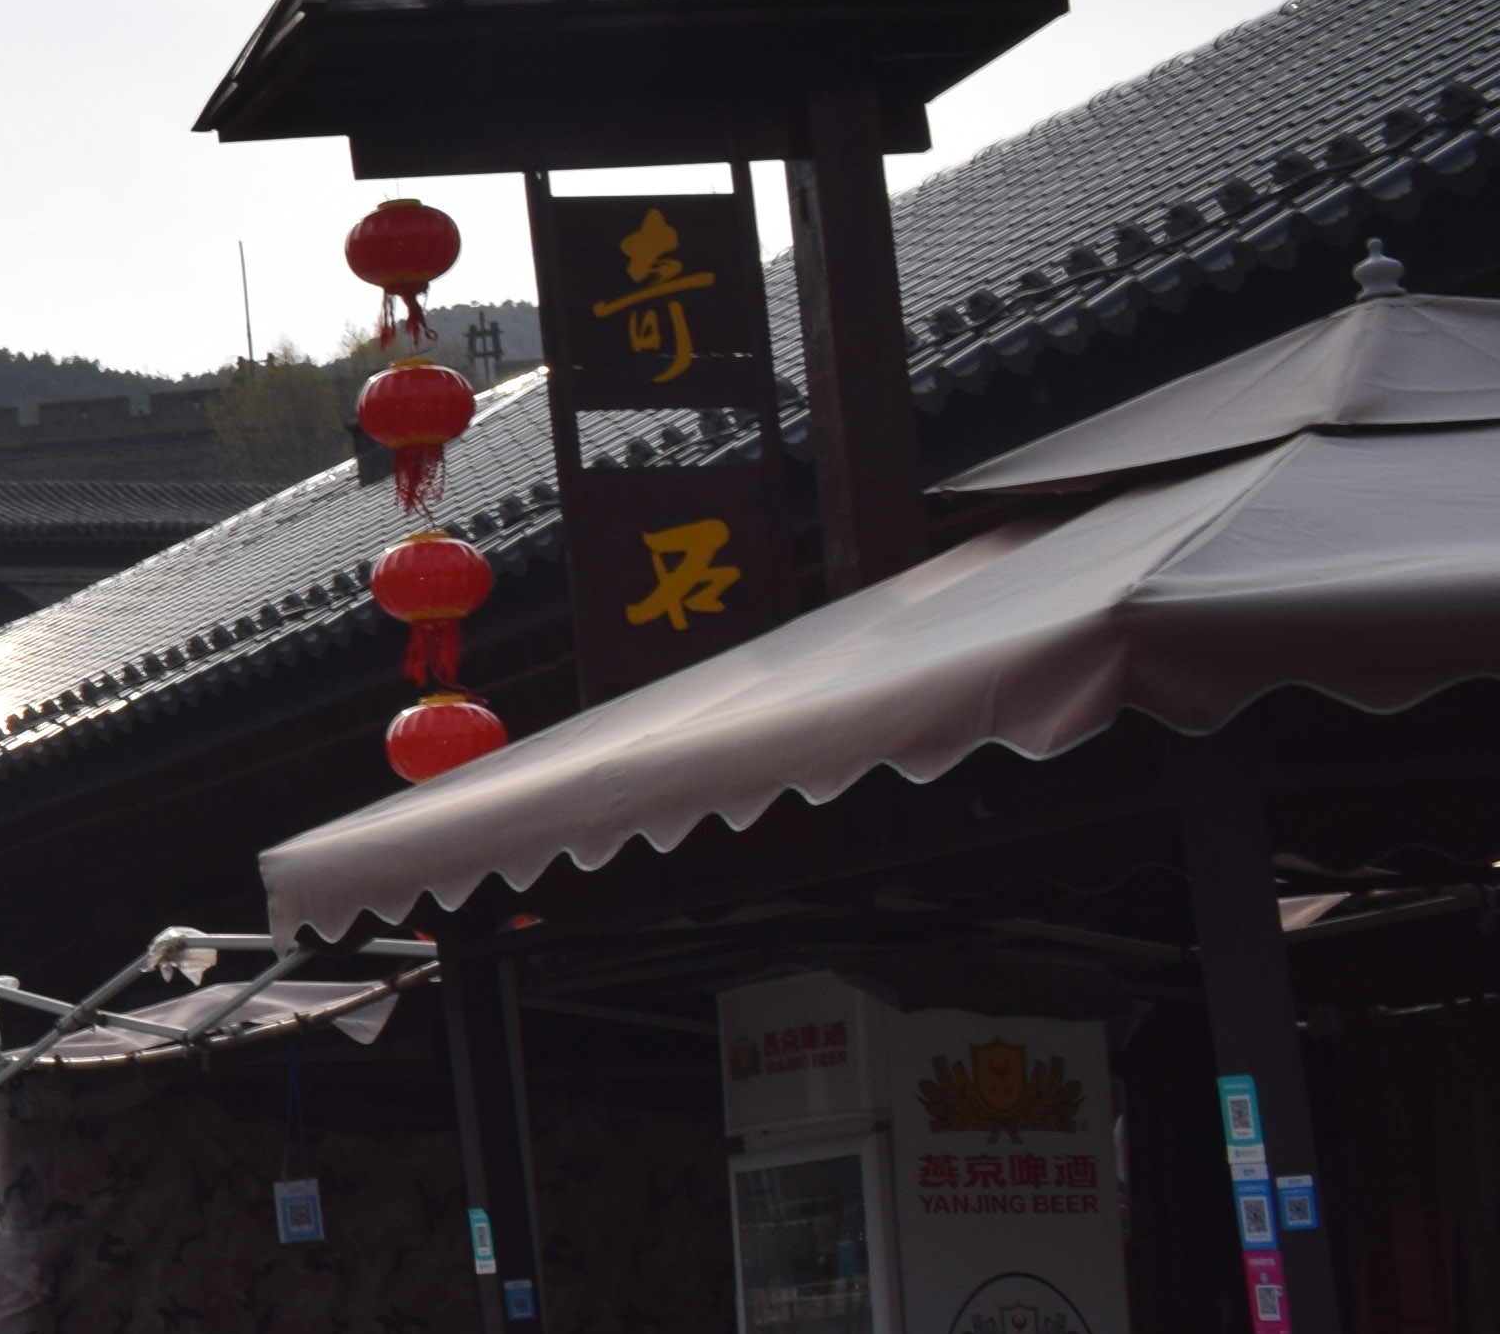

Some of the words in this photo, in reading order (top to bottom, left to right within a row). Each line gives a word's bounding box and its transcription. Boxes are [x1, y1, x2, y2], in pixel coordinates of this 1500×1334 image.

[589, 206, 744, 634] 奇石
[762, 1020, 848, 1057] 燕京啤酒
[812, 1049, 849, 1068] BEER
[918, 1153, 1099, 1189] 燕京啤酒
[919, 1194, 1027, 1215] YANJING
[1032, 1194, 1100, 1215] BEER
